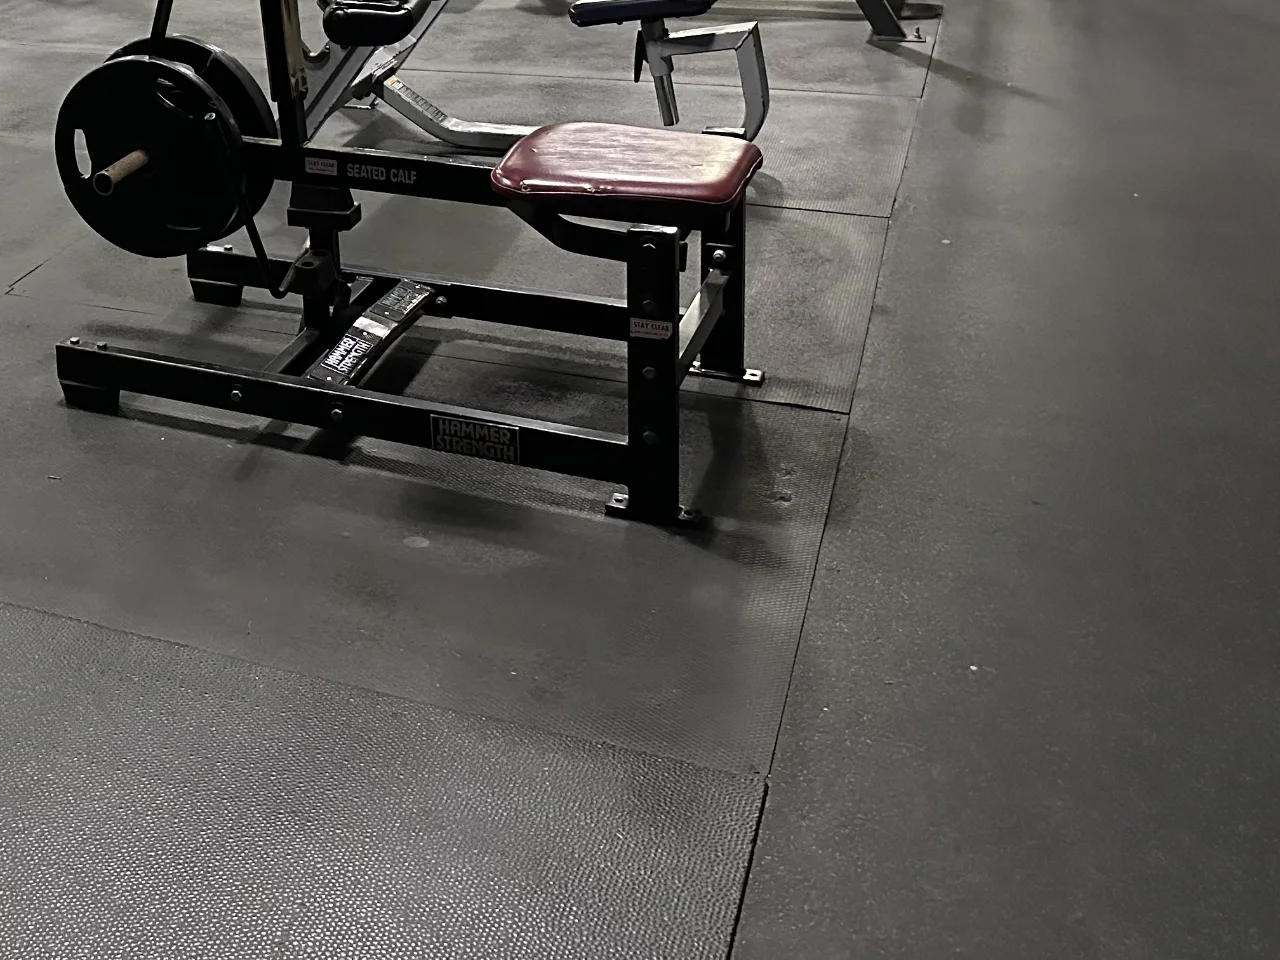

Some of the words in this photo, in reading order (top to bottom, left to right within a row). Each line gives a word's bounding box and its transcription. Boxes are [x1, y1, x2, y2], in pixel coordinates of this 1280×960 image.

[346, 163, 386, 181] SEATED
[390, 168, 417, 184] CALF
[633, 321, 650, 329] STAY
[651, 323, 670, 332] CLEAR
[439, 419, 511, 444] HAMMER
[436, 435, 514, 460] STRENGTH
